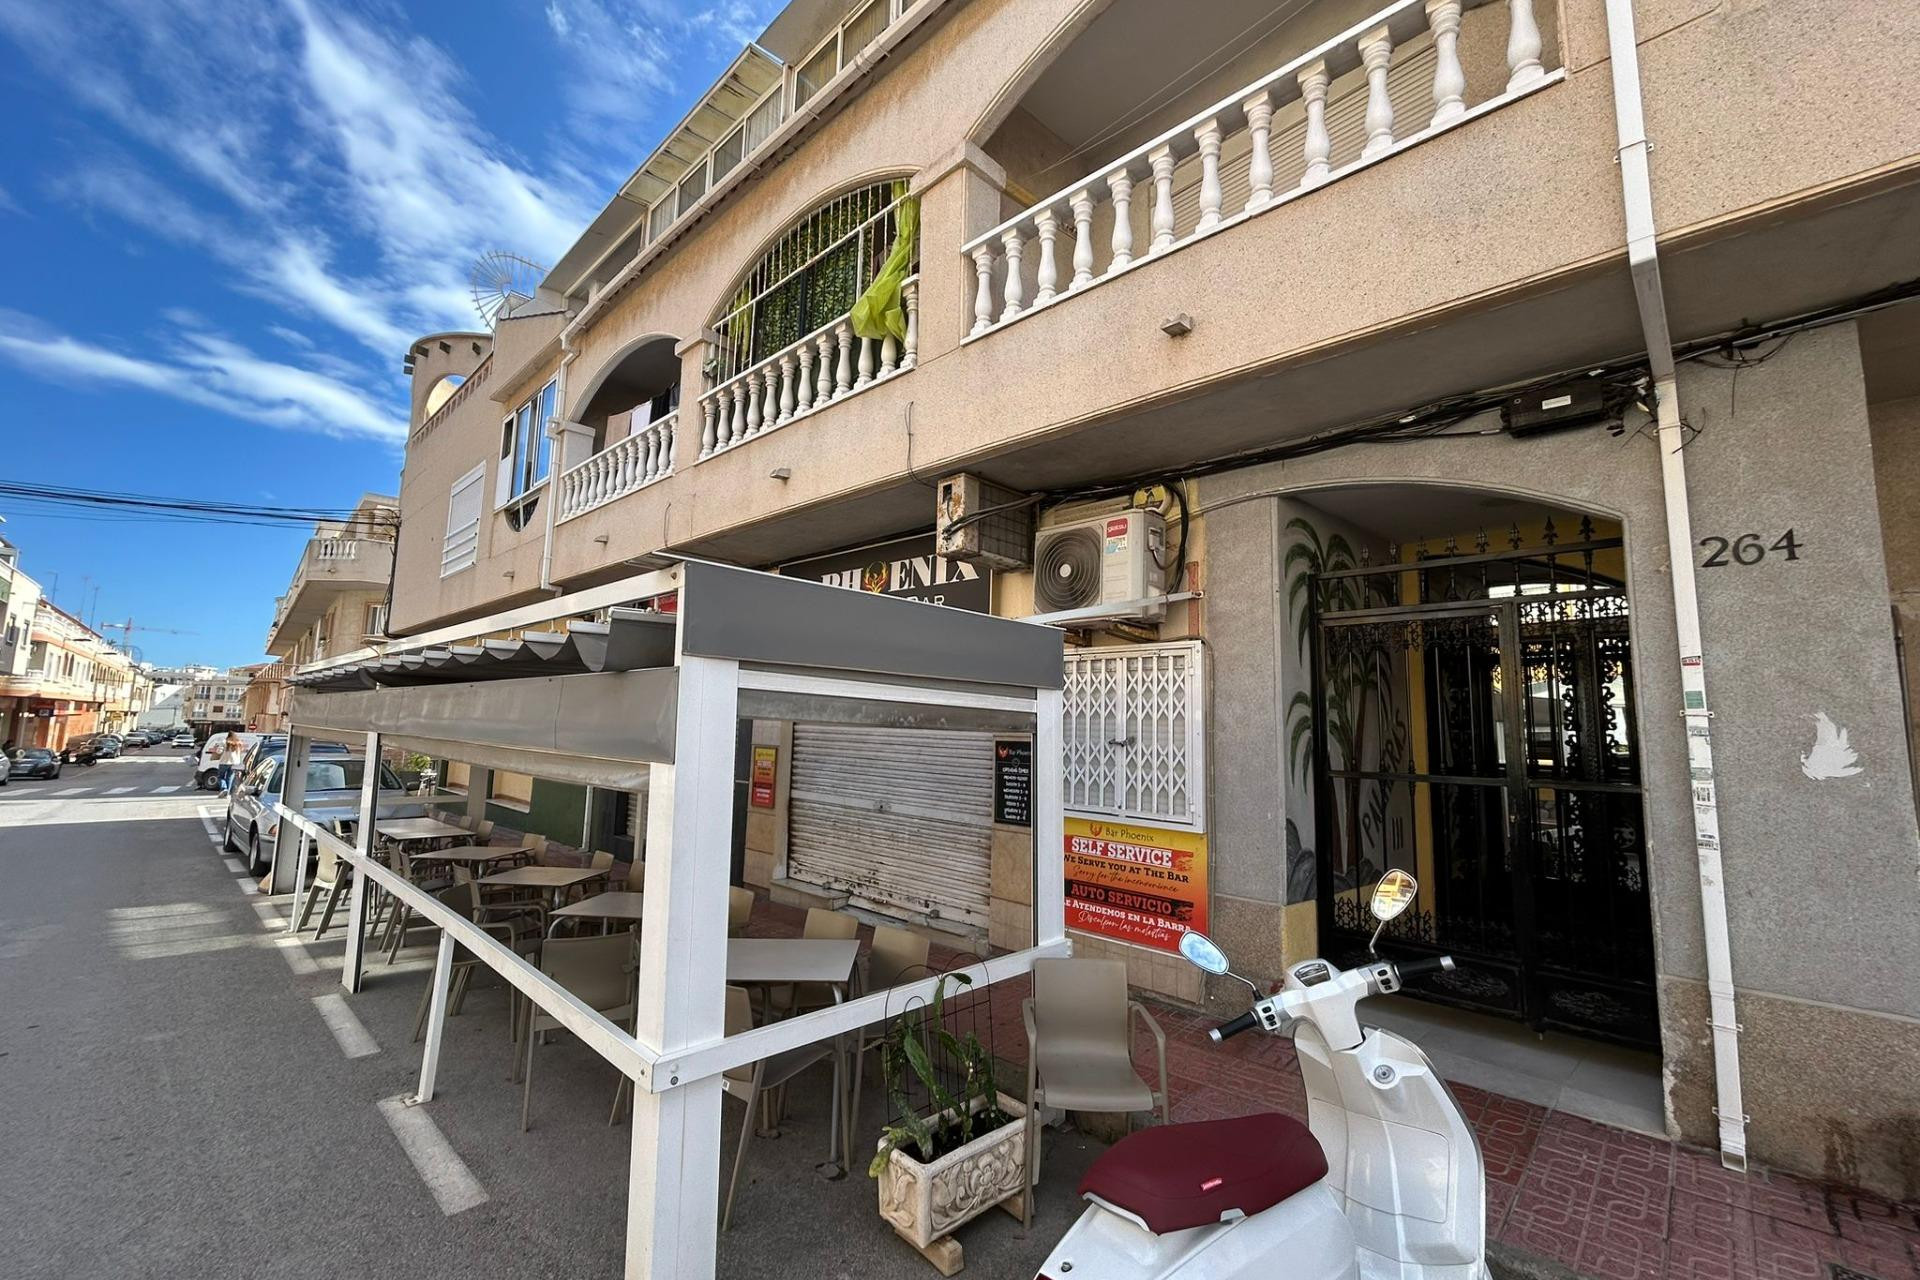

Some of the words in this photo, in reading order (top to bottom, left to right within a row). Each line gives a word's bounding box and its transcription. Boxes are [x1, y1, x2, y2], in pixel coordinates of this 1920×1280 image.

[1700, 528, 1804, 568] 264
[1105, 826, 1119, 837] Bar
[1120, 827, 1154, 842] Phoenix
[1071, 837, 1105, 856] SELF
[1107, 843, 1173, 868] SERVICE
[1077, 856, 1106, 868] SERVE
[1108, 862, 1127, 872] YOU
[1128, 866, 1141, 875] AT
[1167, 870, 1189, 883] BAR
[1071, 883, 1105, 901] AUTO
[1107, 890, 1172, 914] SERVICIO
[1072, 899, 1126, 919] ATENDEMOS
[1127, 913, 1140, 922] EN
[1142, 916, 1155, 926] LA
